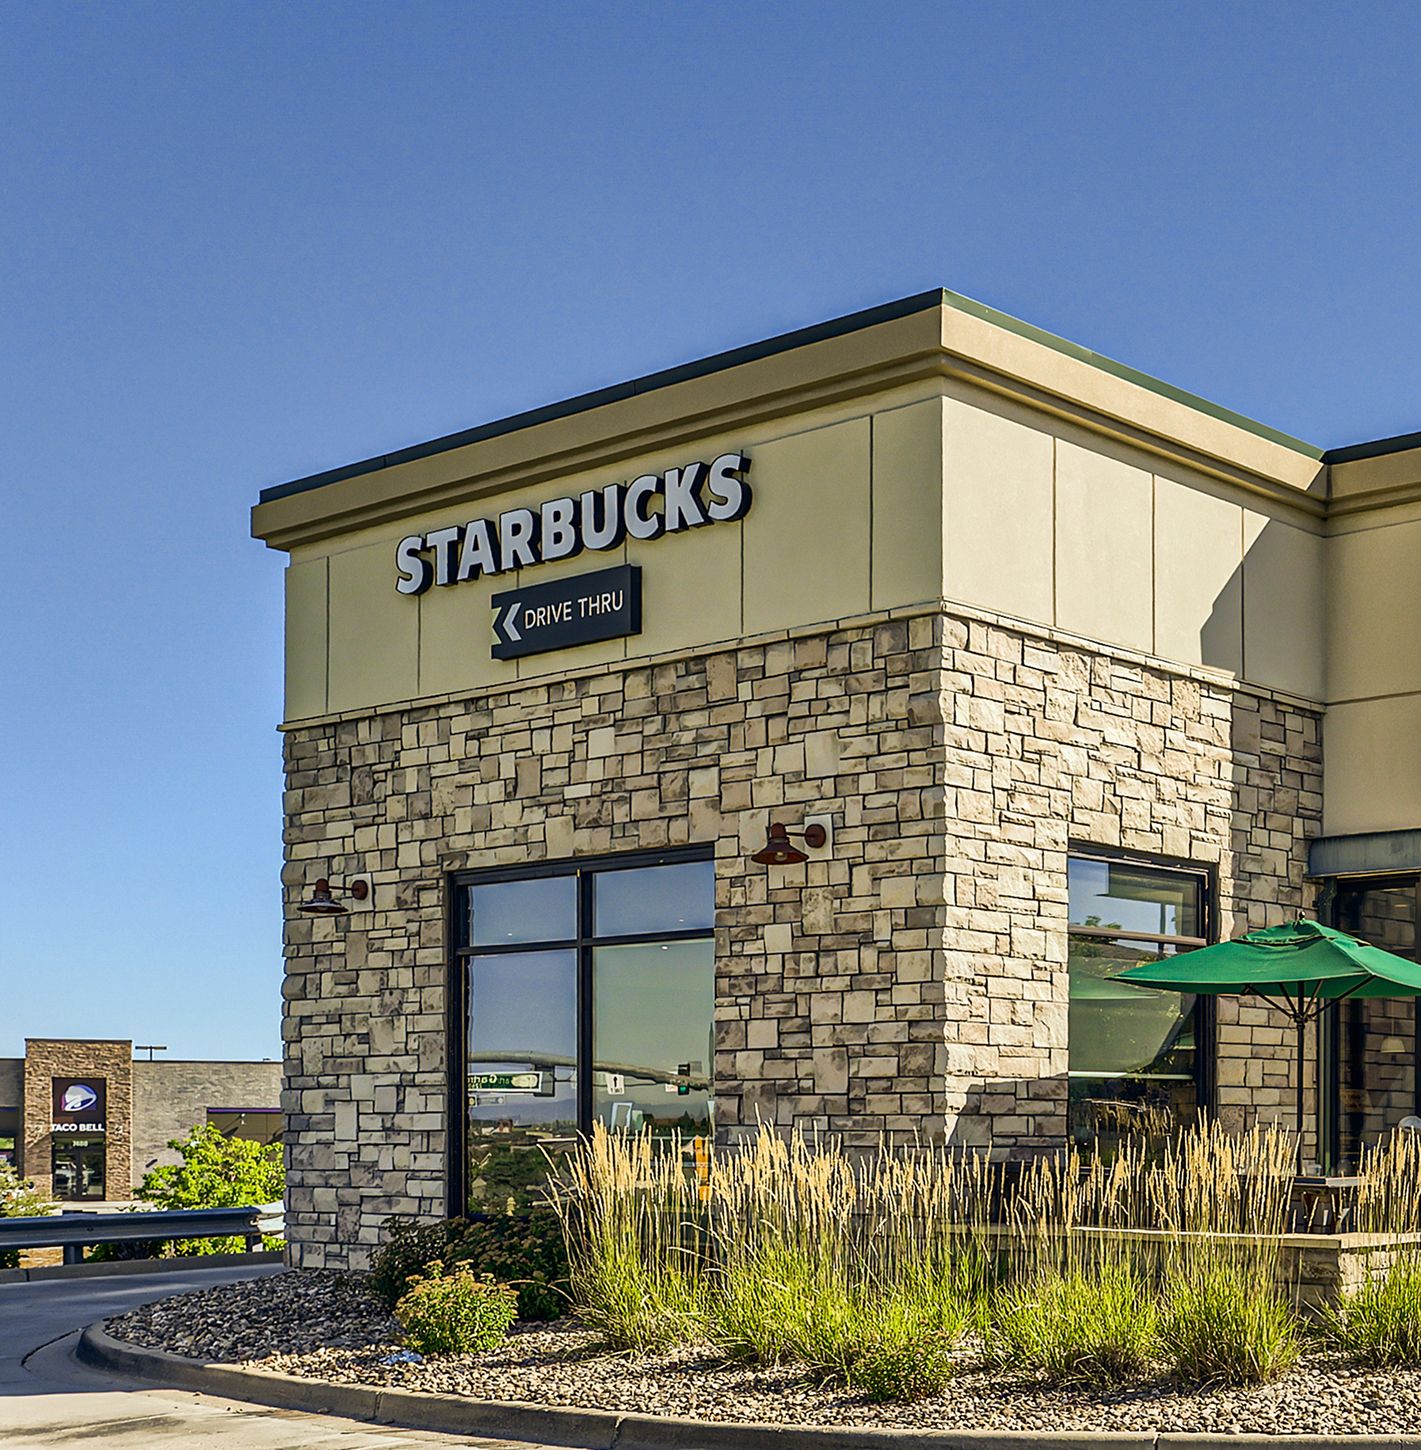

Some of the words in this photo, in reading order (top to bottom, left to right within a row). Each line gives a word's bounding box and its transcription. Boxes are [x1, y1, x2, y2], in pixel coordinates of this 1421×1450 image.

[395, 453, 751, 595] STARBUCKS
[524, 601, 572, 629] DRIVE
[578, 590, 623, 618] THRU
[51, 1123, 77, 1131] TACO
[79, 1123, 104, 1131] BELL
